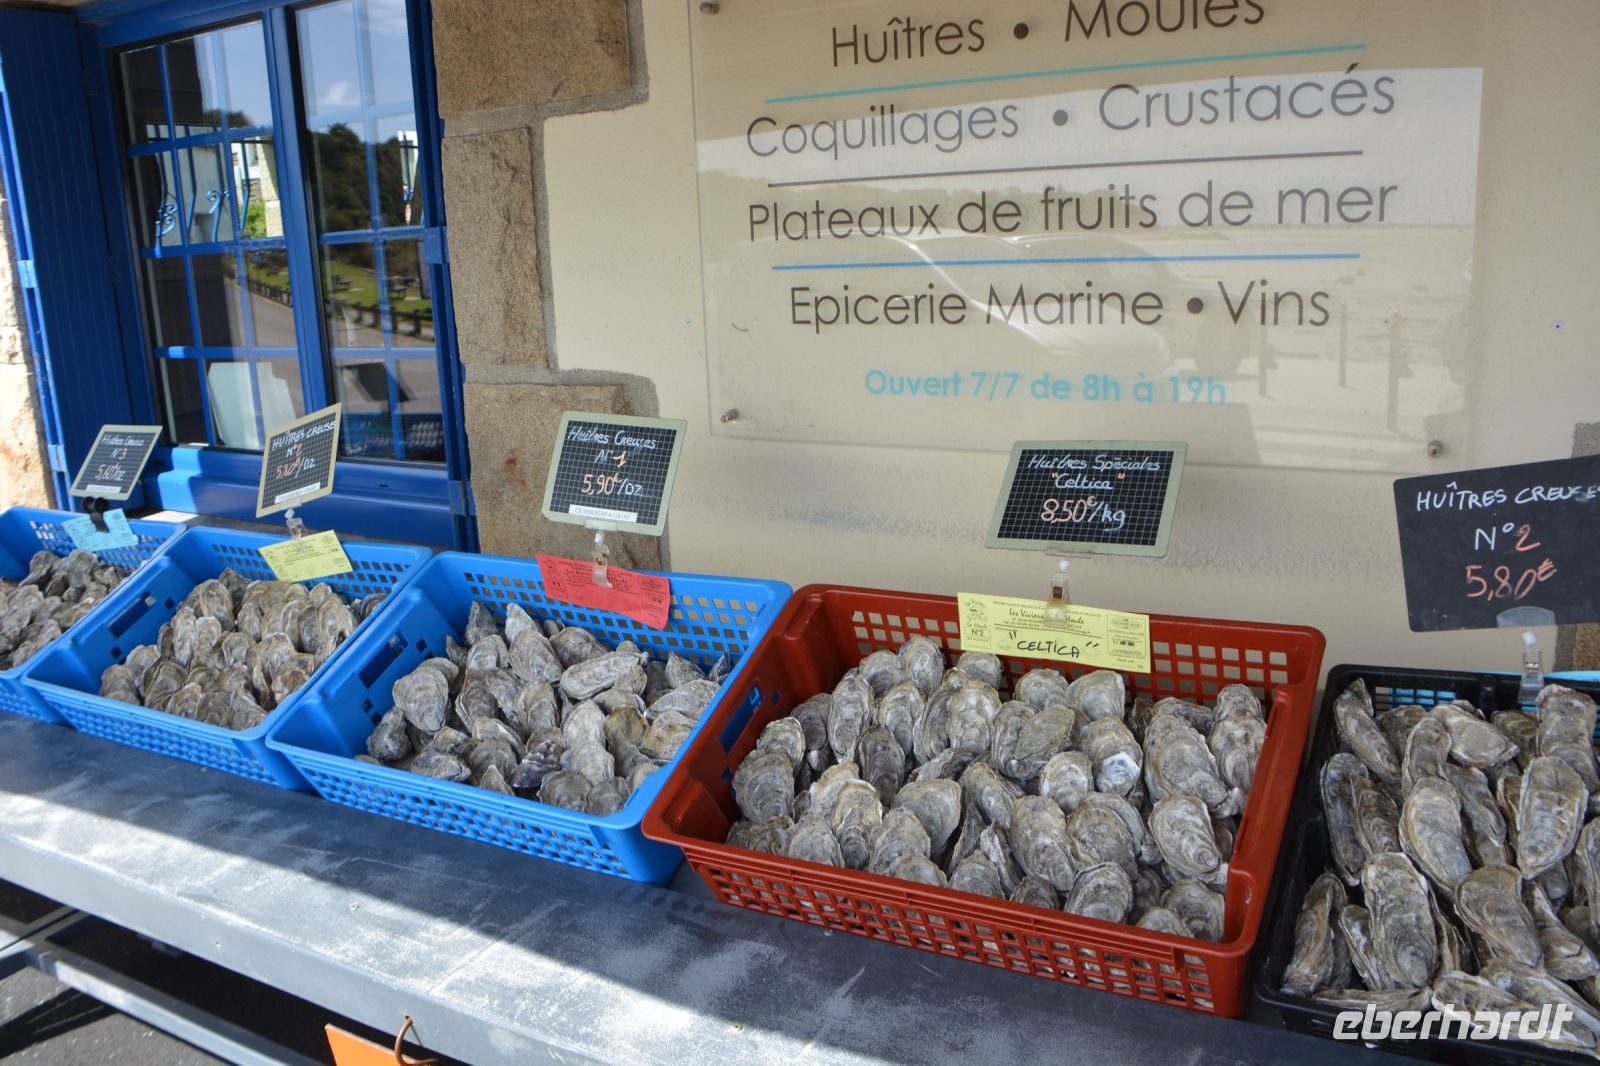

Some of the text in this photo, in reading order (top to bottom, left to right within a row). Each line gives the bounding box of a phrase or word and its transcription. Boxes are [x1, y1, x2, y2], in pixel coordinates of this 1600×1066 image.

[831, 0, 1264, 67] Huîtres Moules
[746, 64, 1396, 160] Coquillages Crustacés
[748, 179, 1398, 242] Plateaux de fruits de mer
[791, 280, 1331, 333] Epicerie Marine Vins
[864, 370, 1226, 406] Ouvert 7/7 de 8h à 19h
[1416, 481, 1507, 511] HUÎTRES
